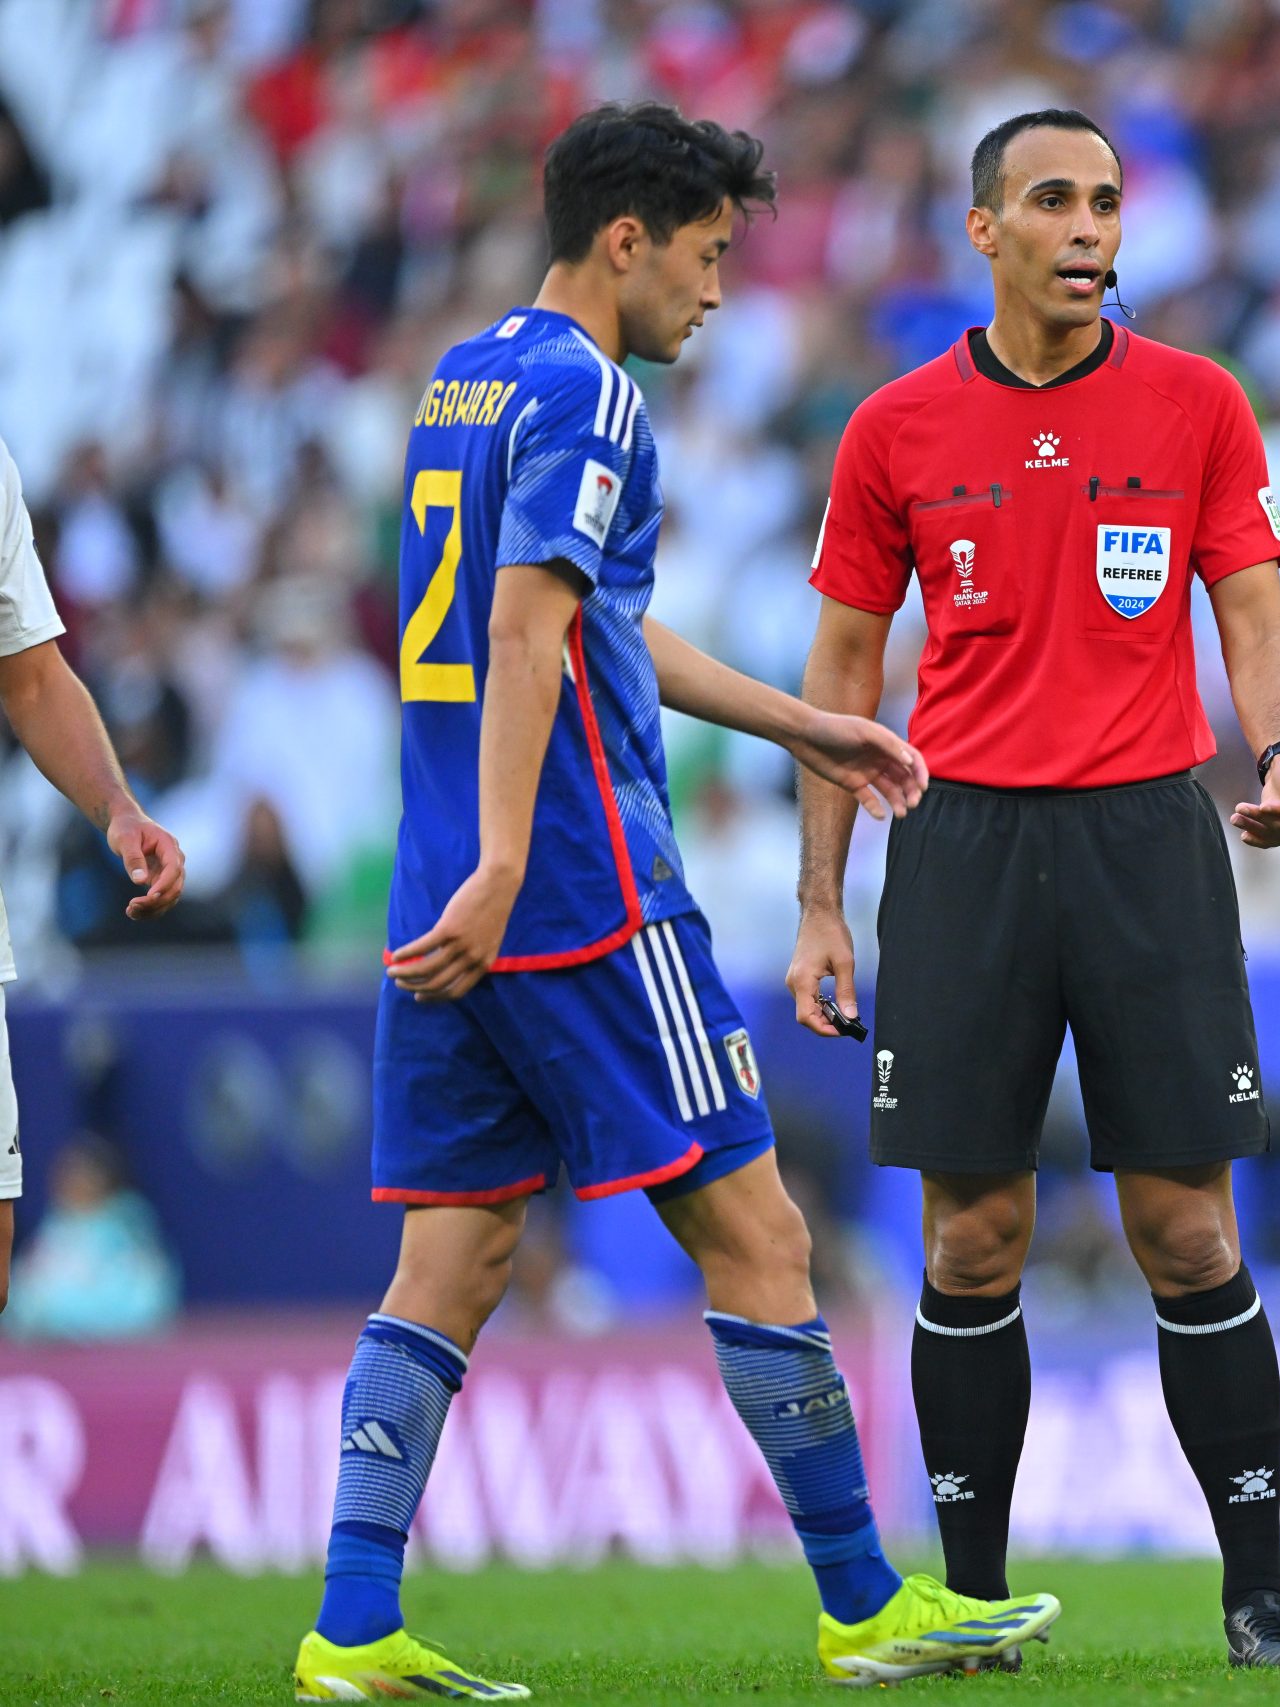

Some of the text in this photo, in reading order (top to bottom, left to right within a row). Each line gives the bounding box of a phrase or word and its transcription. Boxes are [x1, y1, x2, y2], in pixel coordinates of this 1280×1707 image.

[1025, 458, 1070, 469] KELME
[1104, 531, 1164, 554] FIFA
[1103, 567, 1162, 581] REFEREE
[400, 469, 477, 703] 2
[973, 591, 989, 599] CUP
[1117, 598, 1145, 609] 2024
[1228, 1488, 1276, 1504] KELME
